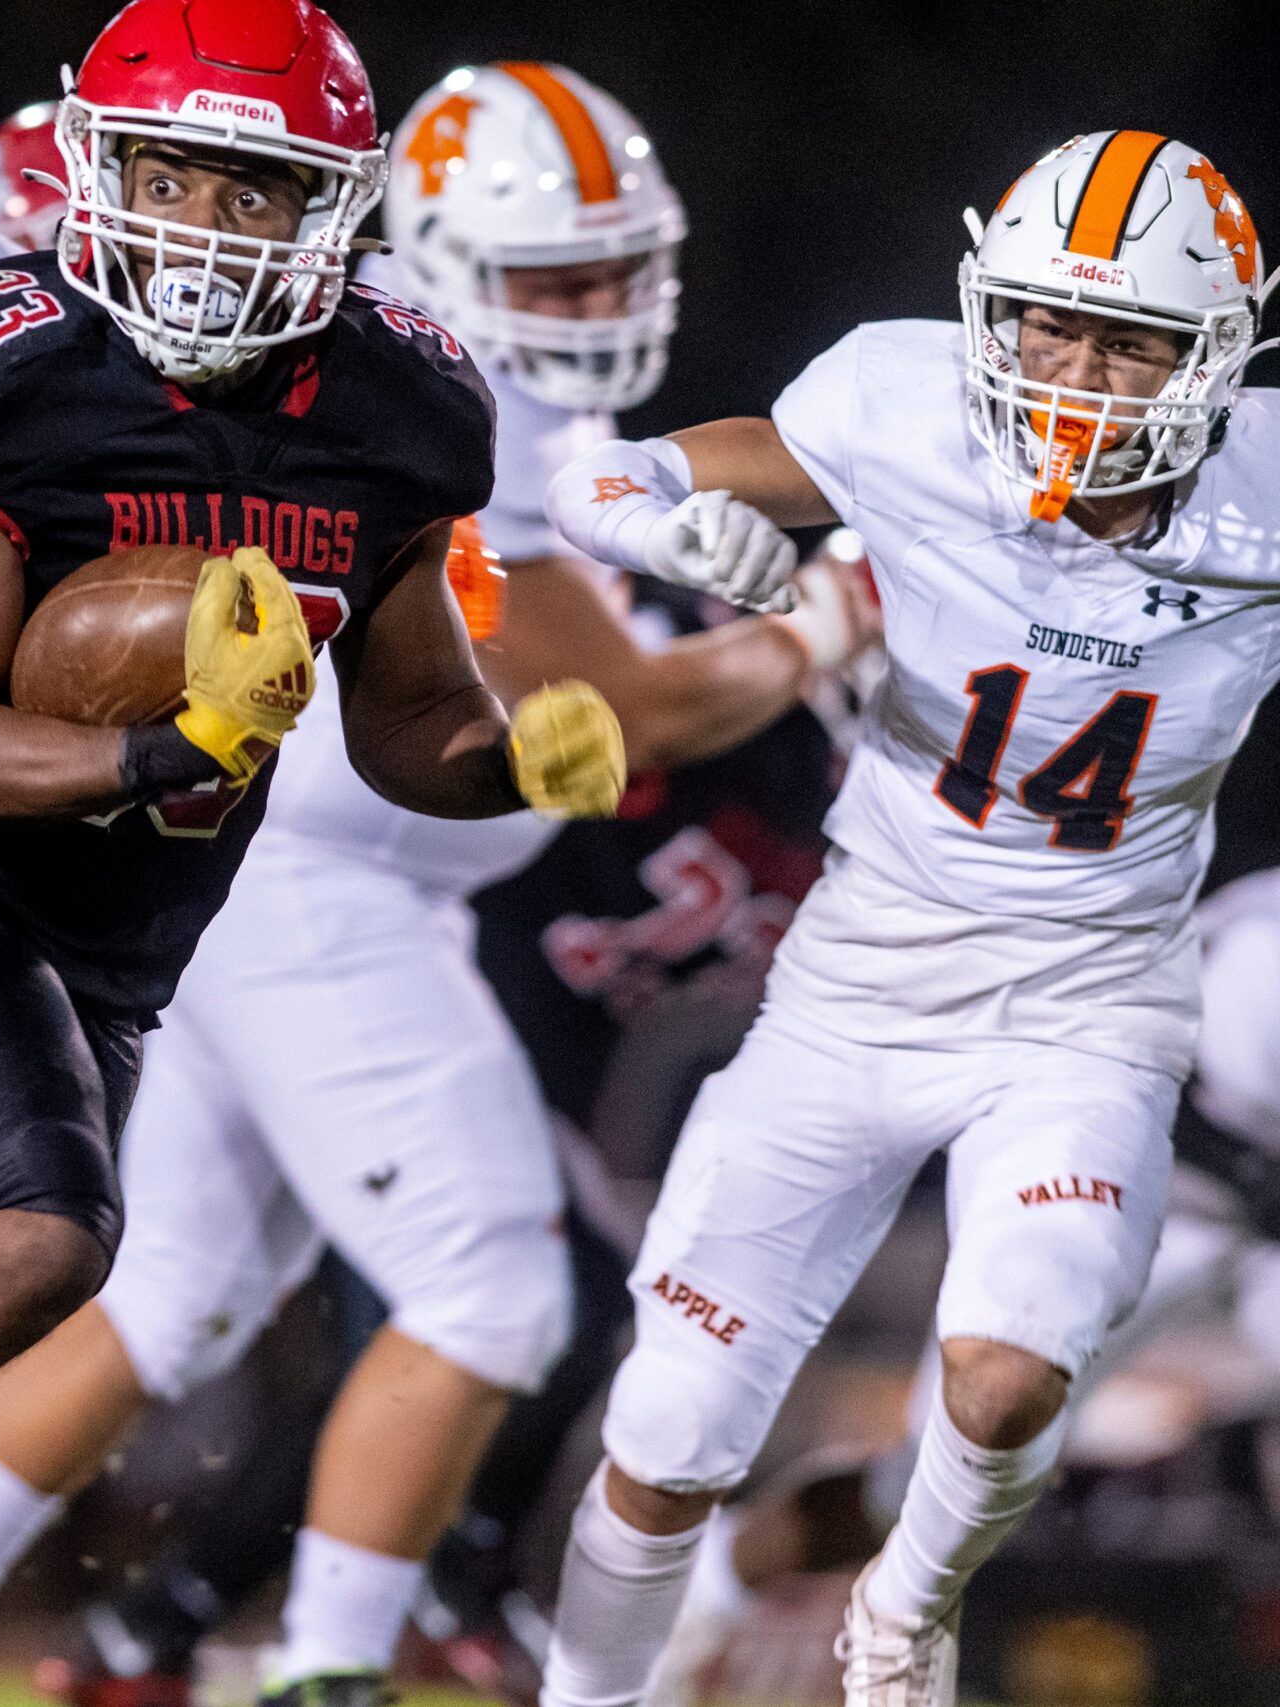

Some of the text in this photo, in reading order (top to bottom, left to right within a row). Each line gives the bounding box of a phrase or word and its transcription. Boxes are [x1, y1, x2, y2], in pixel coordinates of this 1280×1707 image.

[195, 94, 275, 123] Riddell
[170, 337, 213, 354] Riddell
[104, 492, 360, 574] BULLDOGS
[1025, 622, 1144, 668] SUNDEVILS
[931, 662, 1161, 854] 14
[1017, 1175, 1123, 1211] VALLEY
[651, 1273, 747, 1346] APPLE
